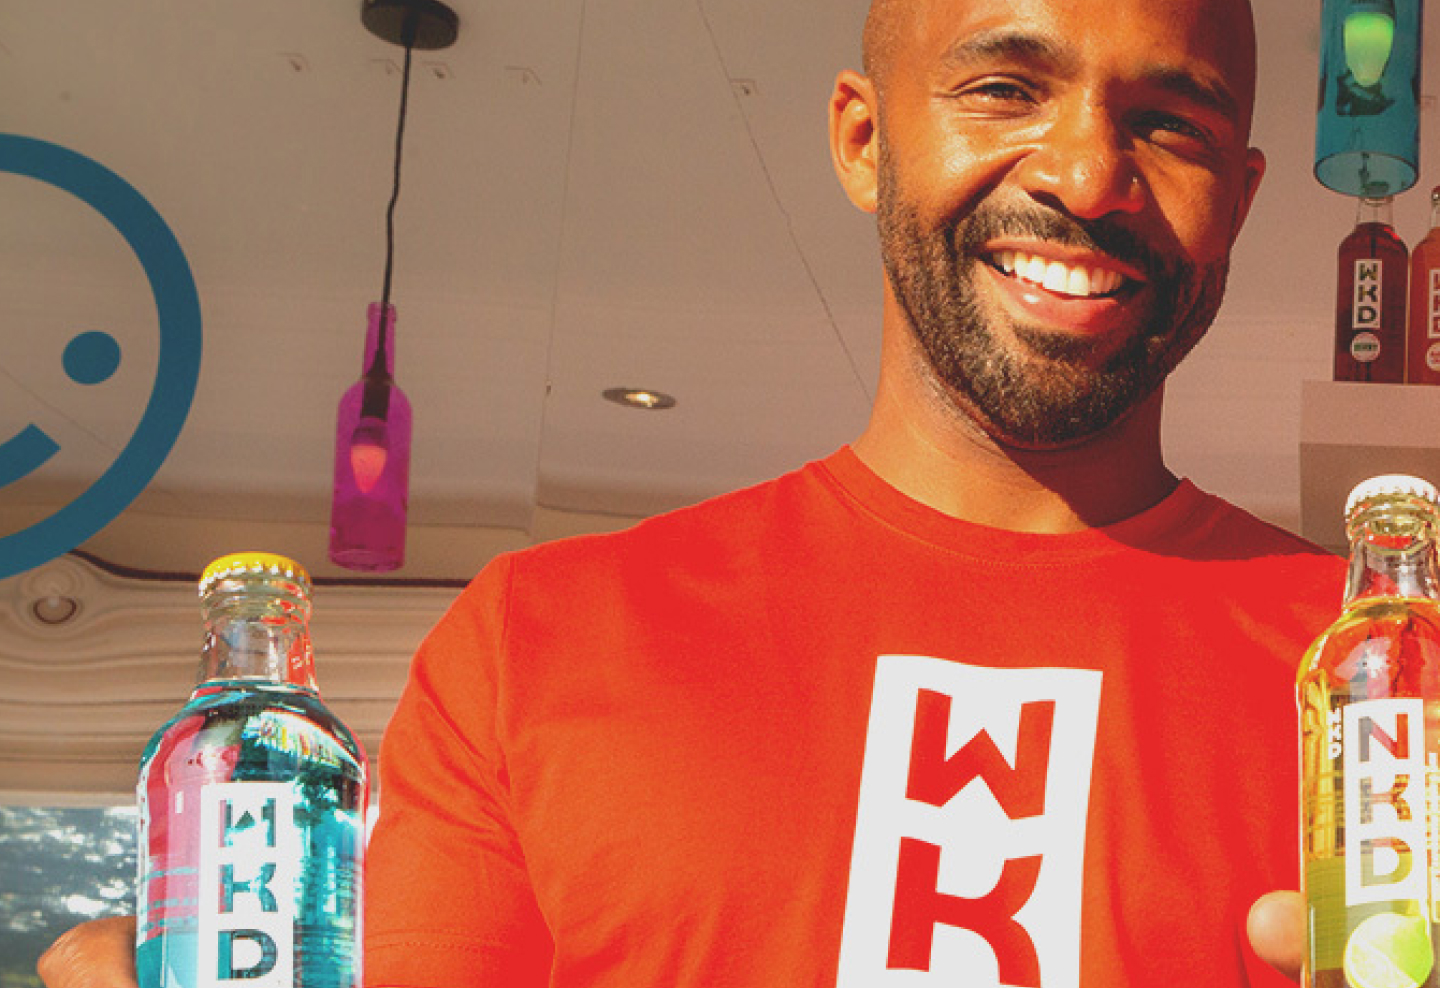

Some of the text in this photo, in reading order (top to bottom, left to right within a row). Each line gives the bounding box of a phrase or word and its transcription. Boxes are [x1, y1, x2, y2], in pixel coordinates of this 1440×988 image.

[1358, 263, 1378, 323] WKD
[1357, 713, 1412, 888] NKD
[217, 798, 278, 981] WKD
